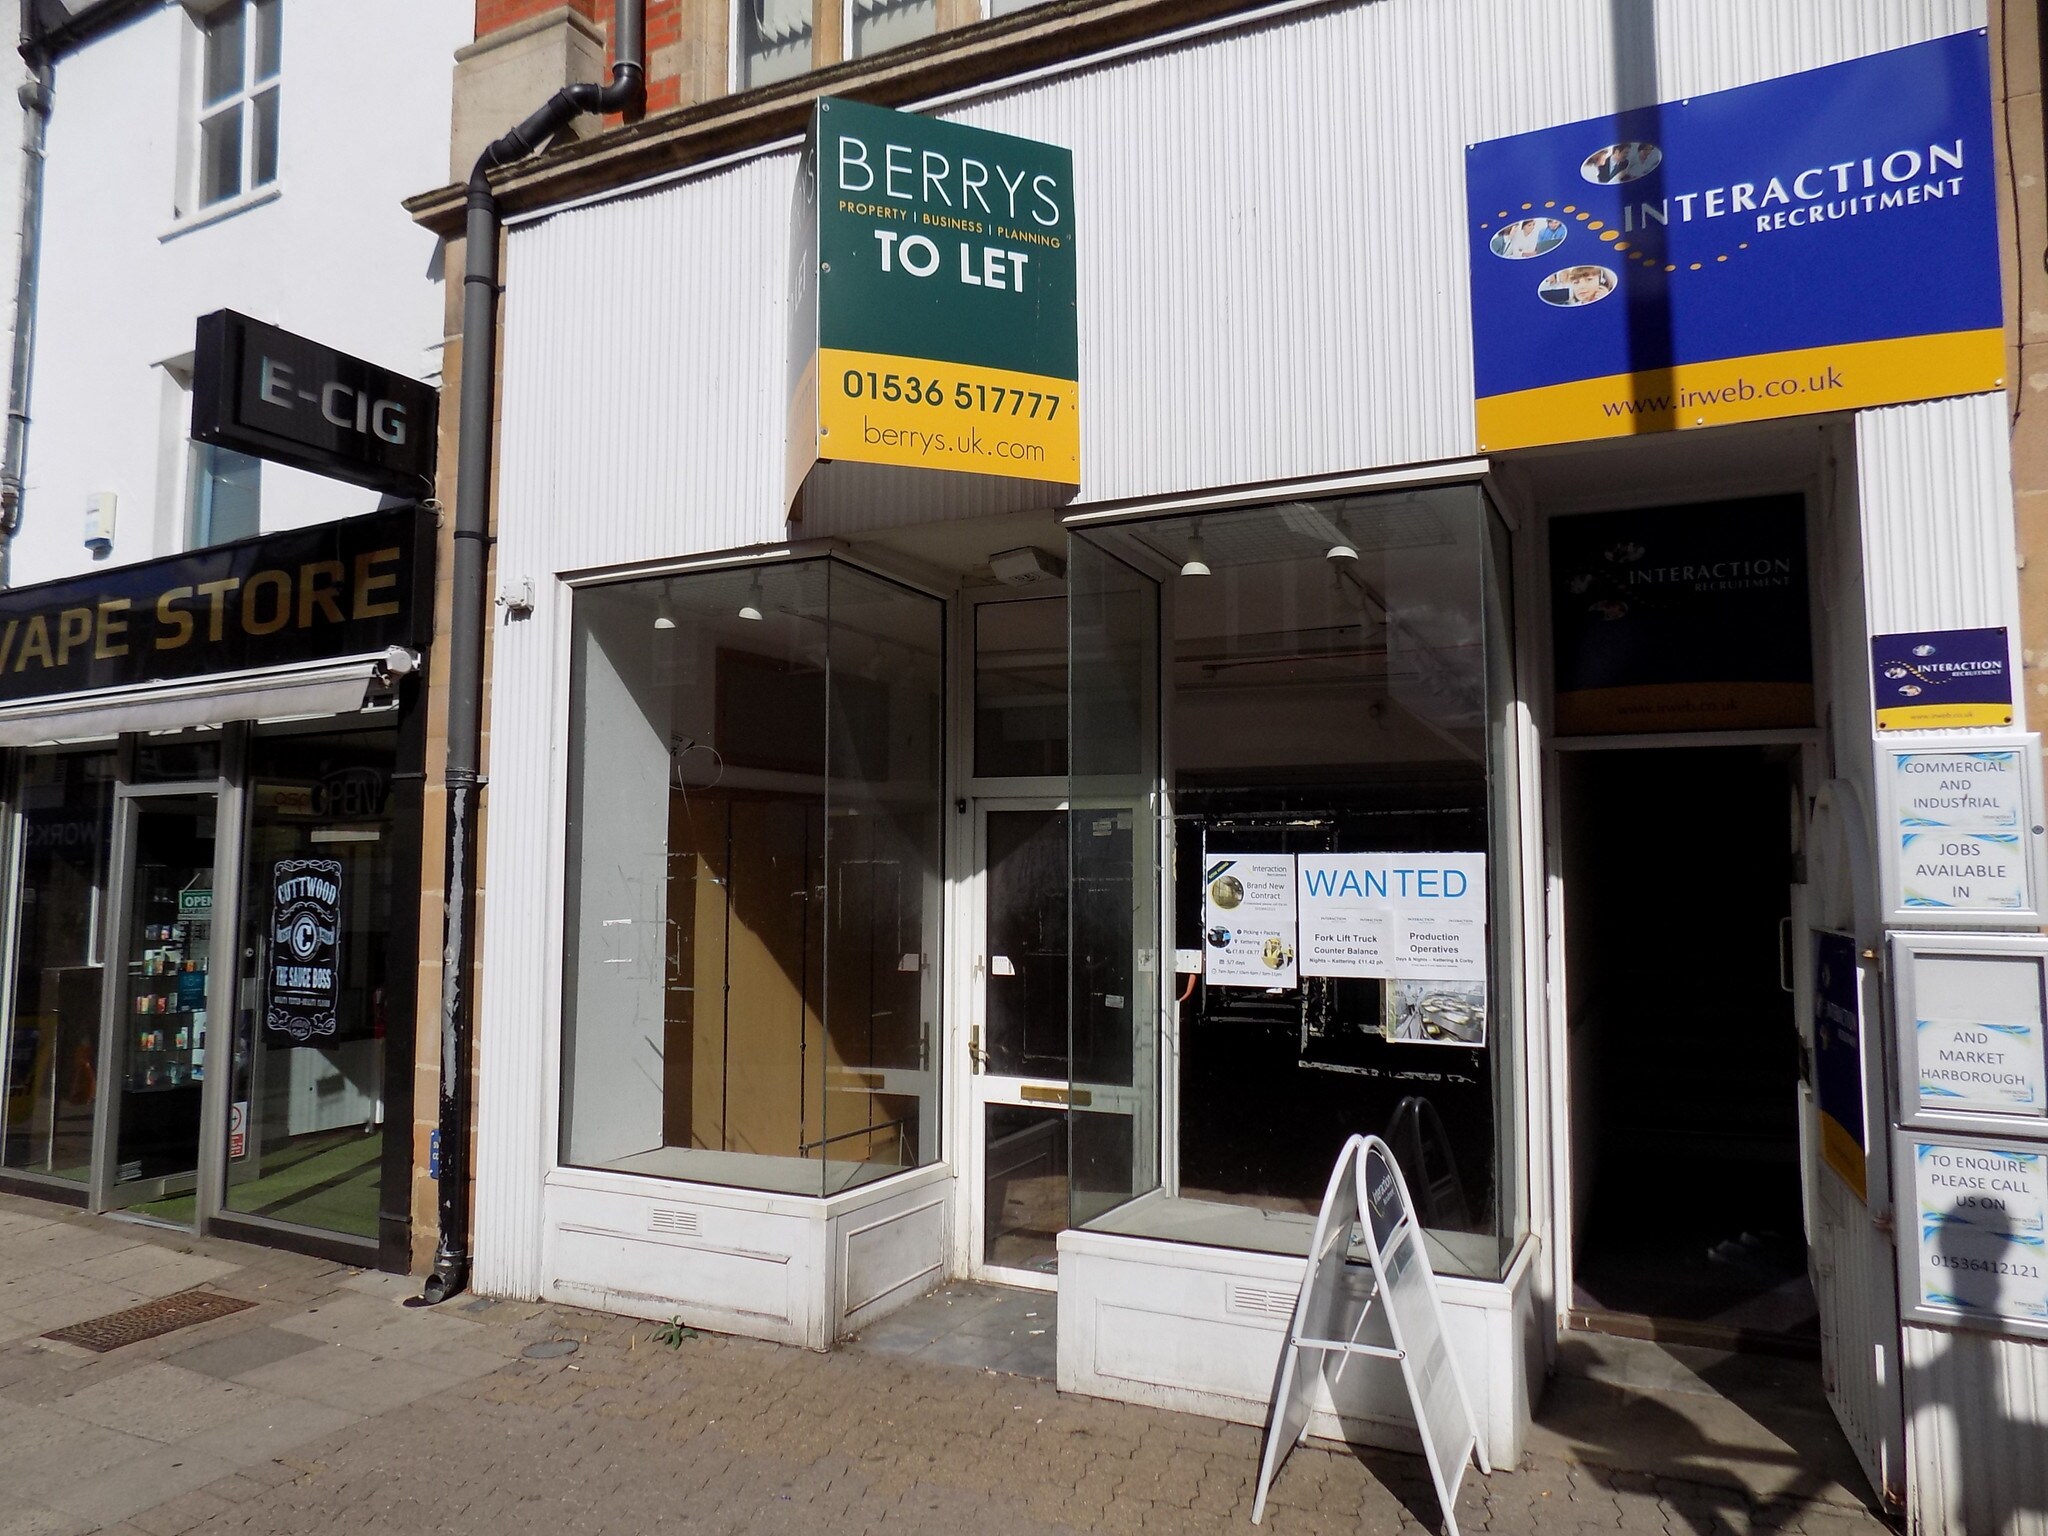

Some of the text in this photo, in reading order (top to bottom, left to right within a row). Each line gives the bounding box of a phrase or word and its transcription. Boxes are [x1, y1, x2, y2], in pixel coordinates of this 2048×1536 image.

[838, 136, 1060, 227] BERRYS
[1624, 138, 1965, 234] INTERACTION
[1756, 177, 1964, 233] RECRUITMENT
[838, 200, 1061, 249] PROPERTY BUSINESS PLANNING
[874, 229, 1029, 293] TO LET
[260, 355, 407, 445] E-CIG
[842, 369, 1060, 421] 01536 517777
[1603, 367, 1844, 419] www.irweb.co.uk
[863, 415, 1045, 463] berrys.uk.com
[1629, 558, 1791, 585] INTERACTION
[1694, 576, 1790, 592] RECRUITMENT
[155, 547, 401, 650] STORE
[1917, 660, 2002, 673] INTERACTION
[1904, 761, 2006, 774] COMMERCIAL
[1939, 780, 1972, 790] AND
[1913, 797, 2000, 809] INDUSTRIAL
[1939, 843, 1981, 856] JOBS
[1252, 865, 1287, 873] Interaction
[1915, 864, 2006, 878] AVAILABLE
[277, 876, 337, 905] CUTTWOOD
[1246, 881, 1285, 890] Brand New
[1304, 869, 1467, 898] WANTED
[1250, 891, 1281, 900] Contract
[1952, 886, 1970, 898] IN
[1314, 933, 1378, 943] Fork Lift Truck
[1409, 932, 1460, 941] Production
[1313, 946, 1379, 956] Counter Balance
[1409, 944, 1460, 954] Operatives
[1953, 1031, 1989, 1045] AND
[1939, 1050, 2005, 1065] MARKET
[1921, 1068, 2025, 1086] HARBOROUGH
[1930, 1154, 2027, 1174] TO ENQUIRE
[1931, 1174, 2031, 1194] PLEASE CALL
[1956, 1195, 2006, 1211] US ON
[1930, 1254, 2040, 1279] 01536412121
